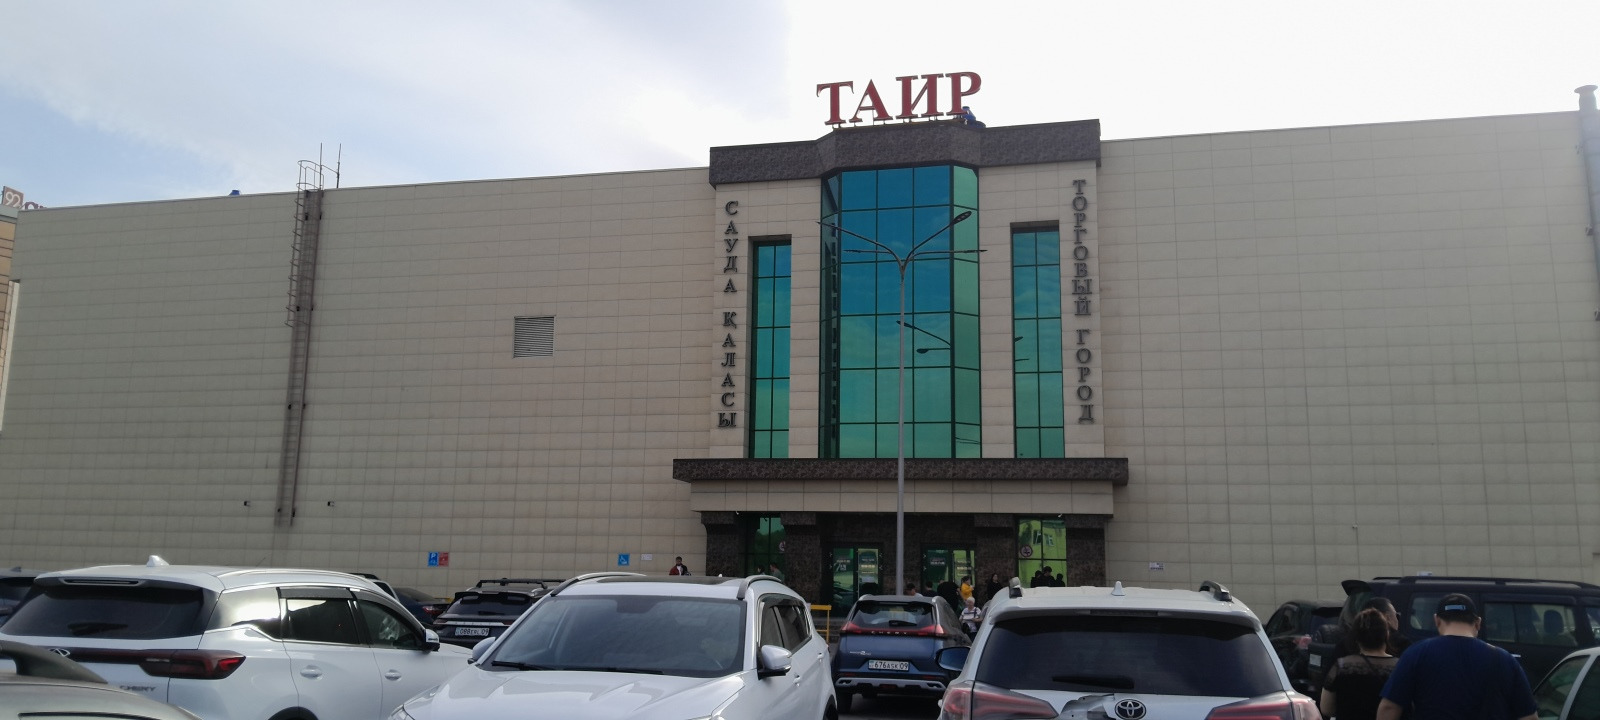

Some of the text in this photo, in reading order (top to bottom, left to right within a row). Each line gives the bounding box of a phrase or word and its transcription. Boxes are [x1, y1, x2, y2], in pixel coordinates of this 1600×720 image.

[816, 71, 982, 125] ТАИР
[717, 200, 739, 428] САУДА ҚАЛАСЫ
[1071, 179, 1095, 425] ТОРГОВЫЙ ГОРОД
